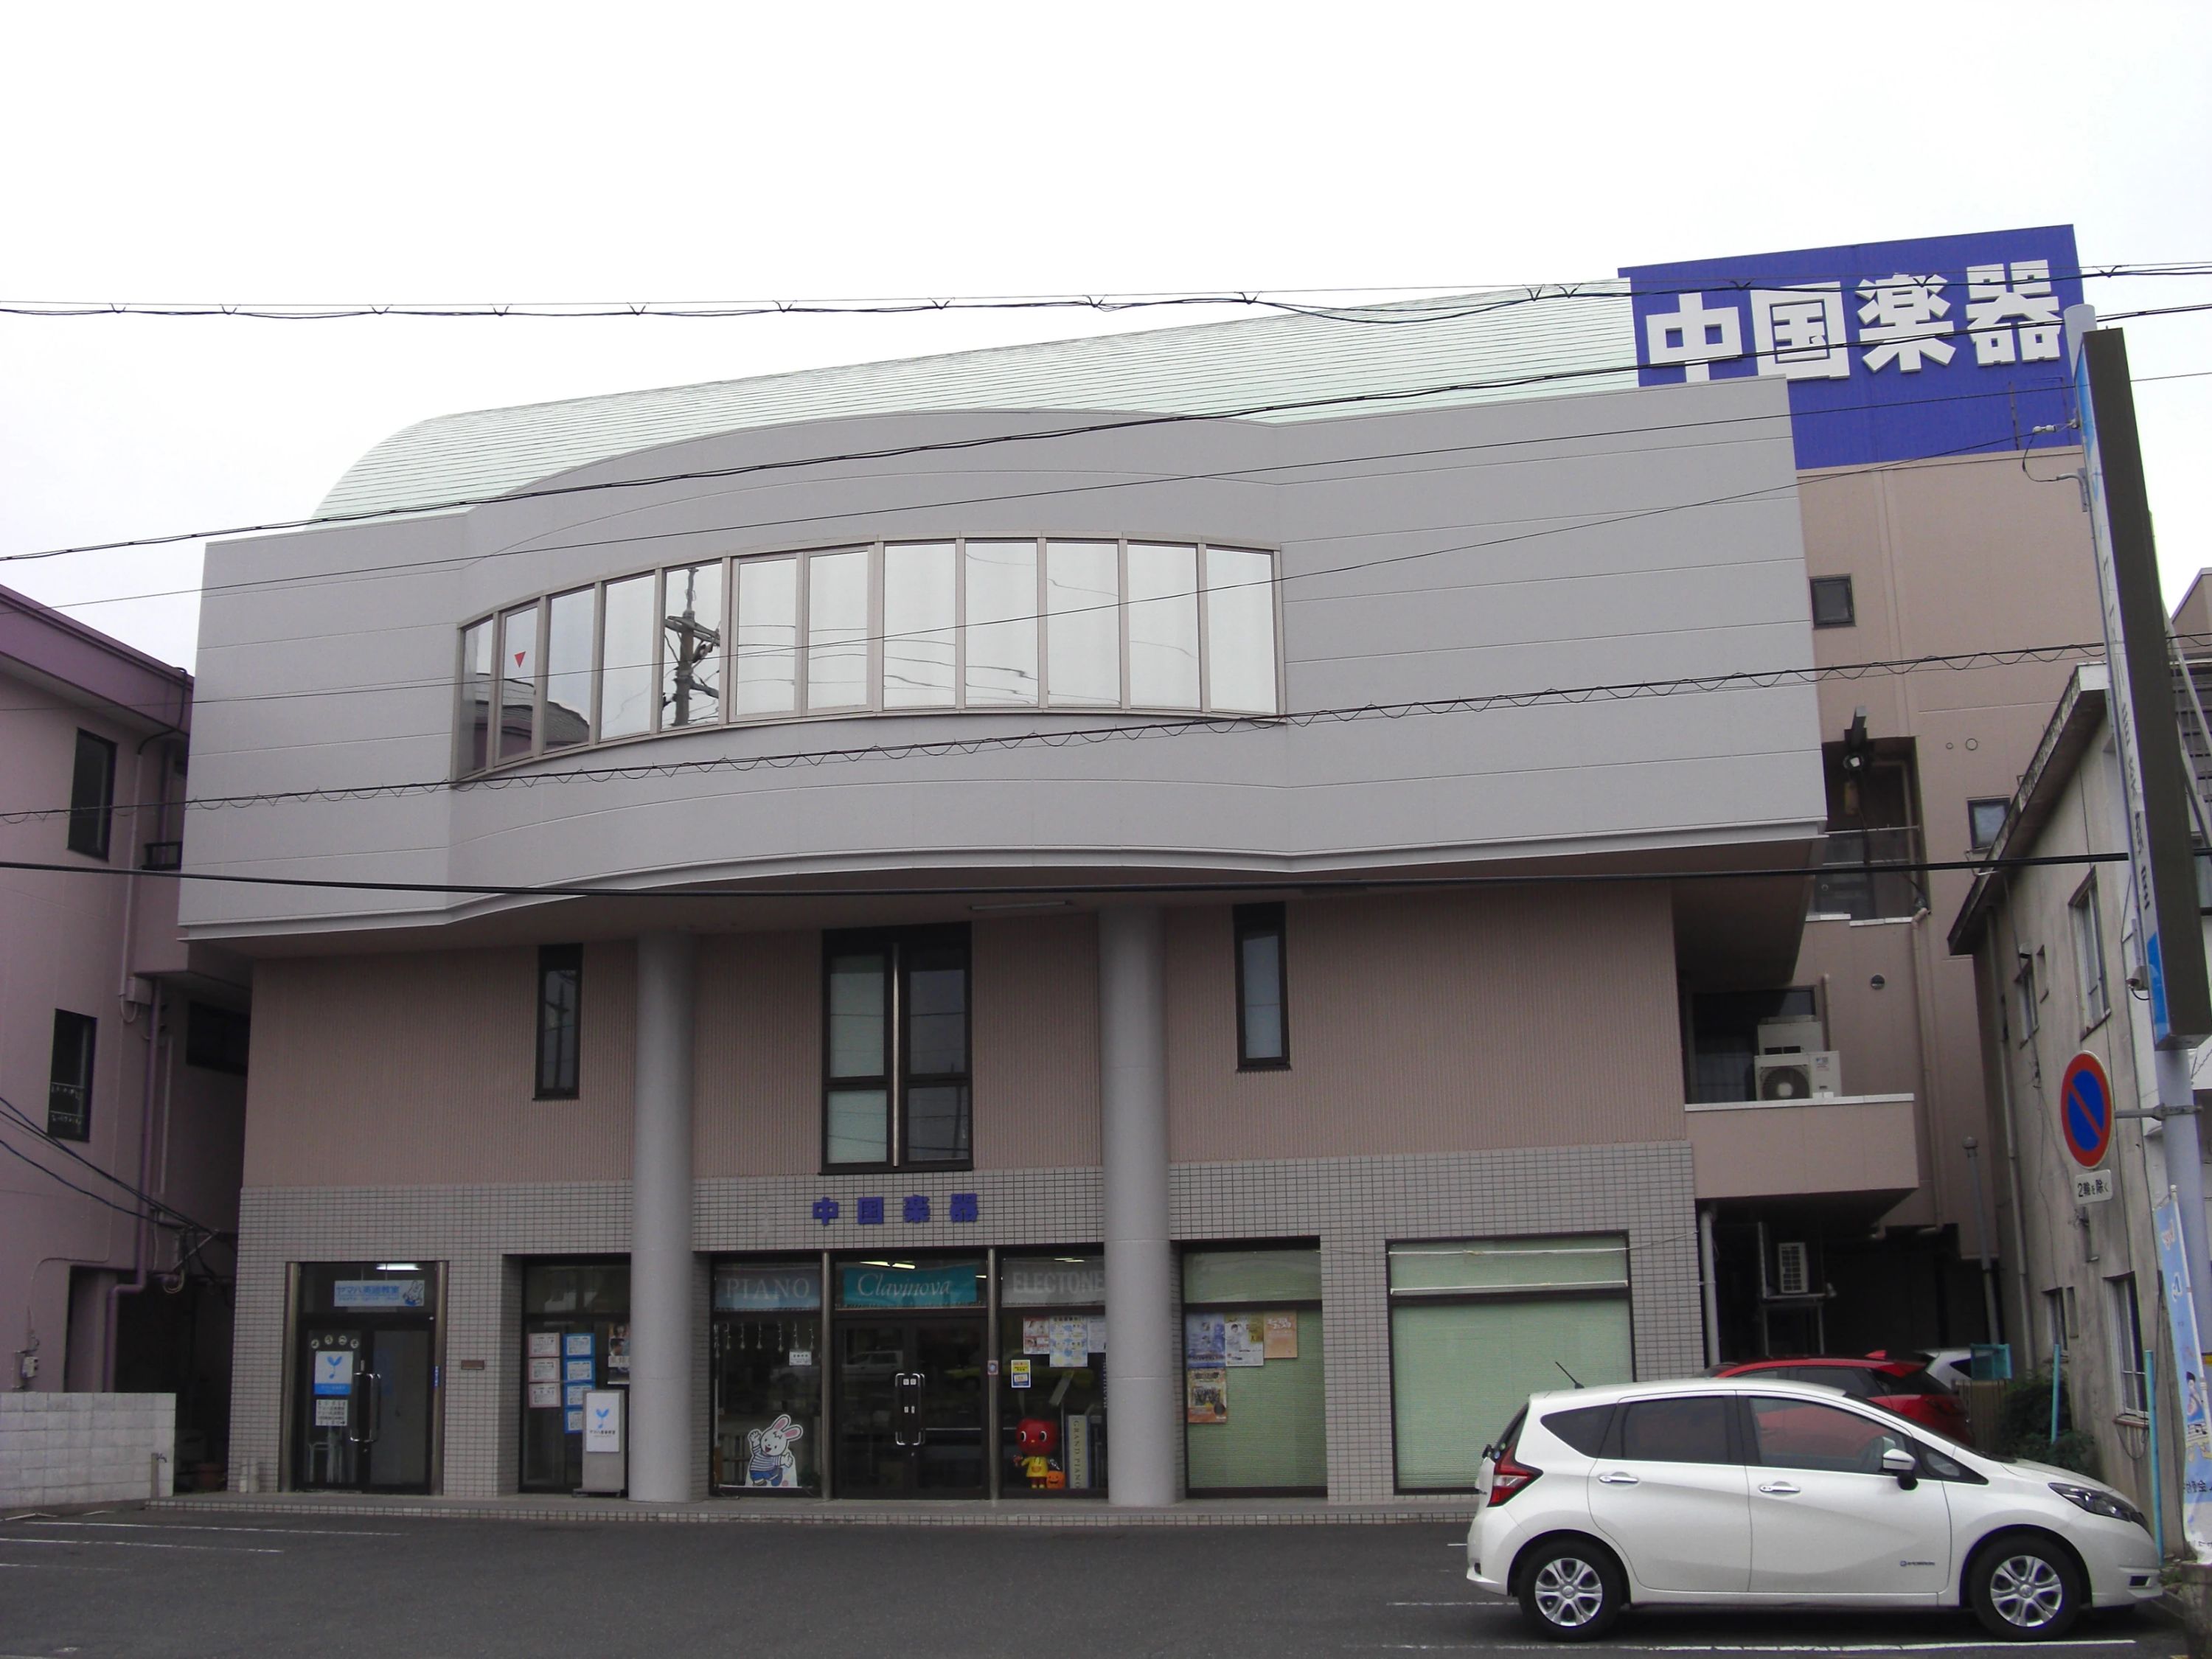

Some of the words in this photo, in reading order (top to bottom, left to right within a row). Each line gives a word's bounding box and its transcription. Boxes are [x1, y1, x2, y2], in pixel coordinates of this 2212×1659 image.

[1646, 260, 2062, 381] 中国楽器
[813, 1193, 978, 1226] 中国楽器
[726, 1277, 810, 1300] PIANO
[858, 1273, 952, 1298] Clavinova
[1012, 1271, 1105, 1295] ELECTONE
